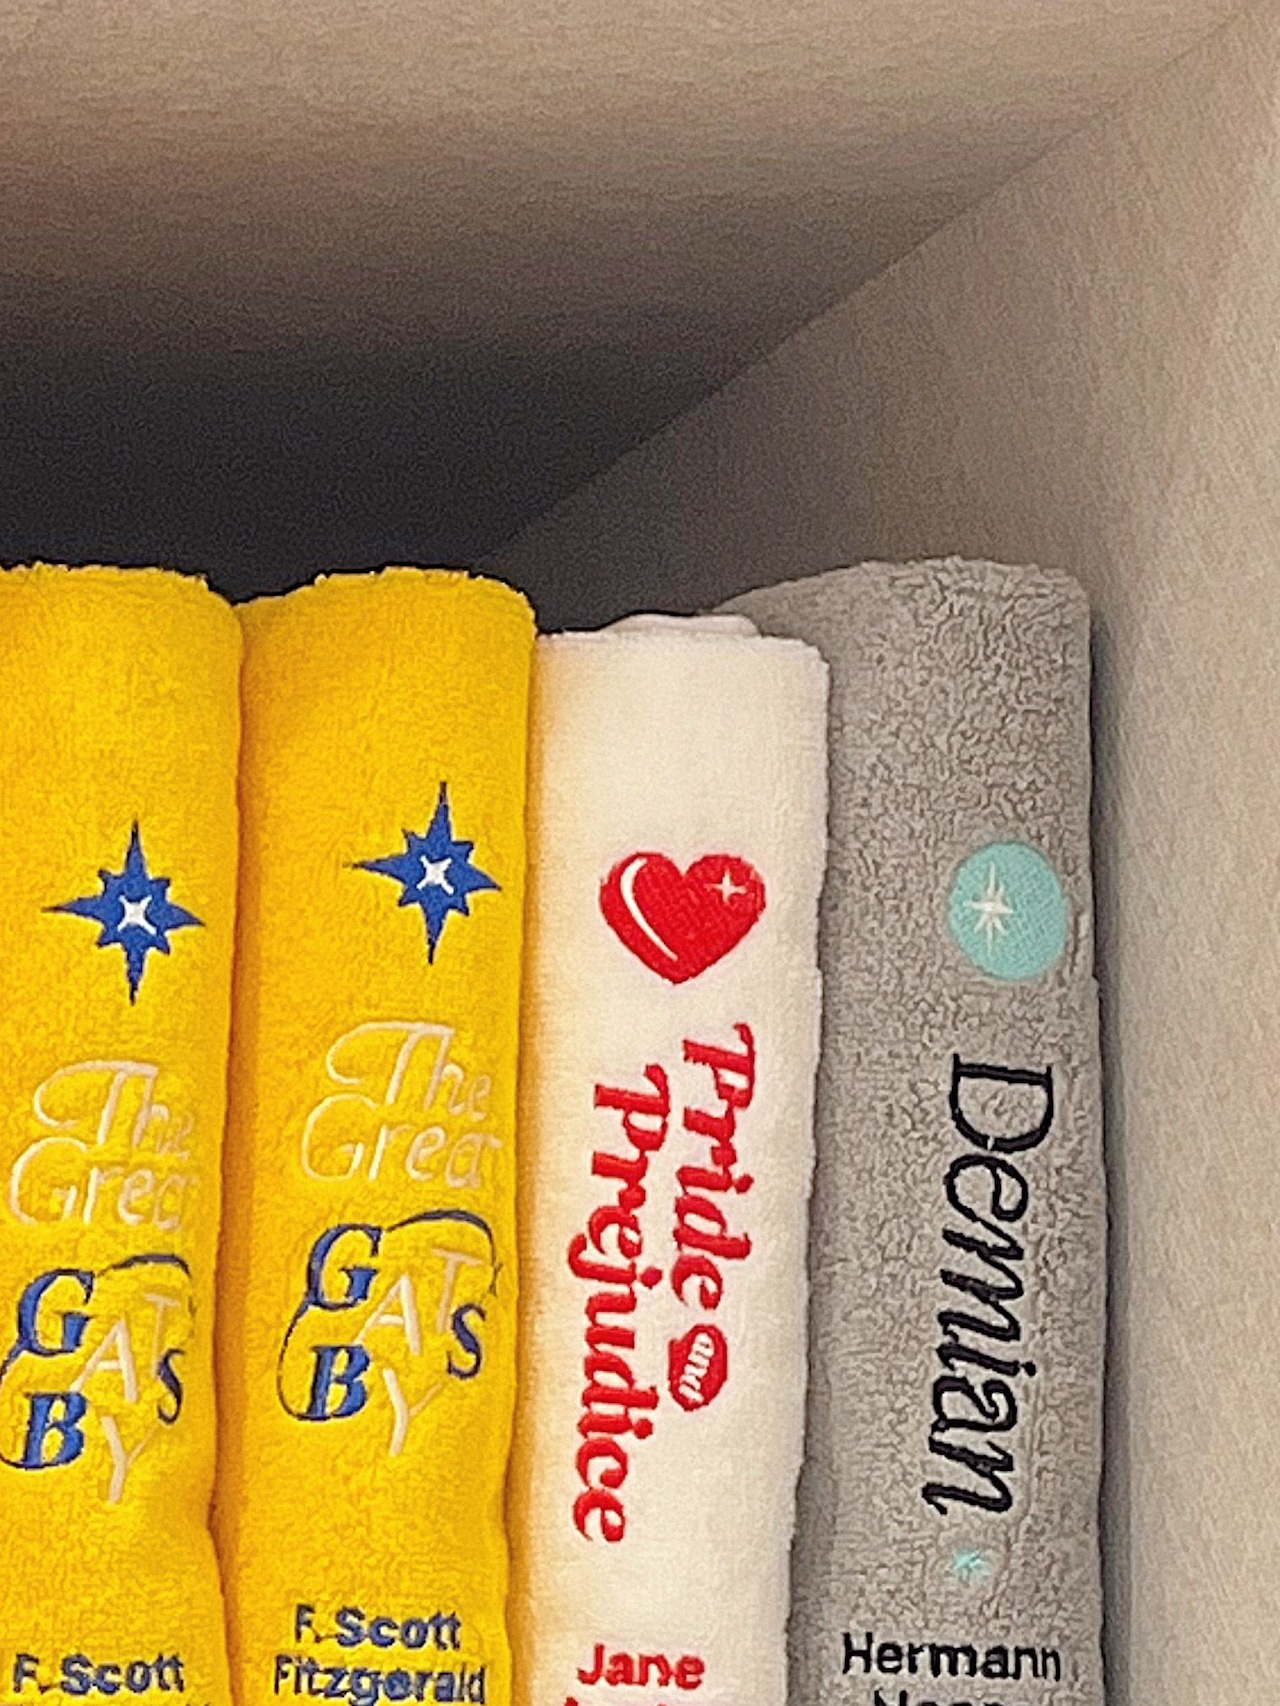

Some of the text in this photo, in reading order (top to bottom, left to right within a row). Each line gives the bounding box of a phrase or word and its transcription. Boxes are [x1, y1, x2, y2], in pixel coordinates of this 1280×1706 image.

[325, 1019, 493, 1122] The
[671, 1021, 757, 1311] Pride
[567, 1063, 670, 1543] Prejudice
[922, 1053, 1055, 1515] Demian
[576, 1642, 708, 1690] Jane
[841, 1631, 1063, 1683] Hermann
